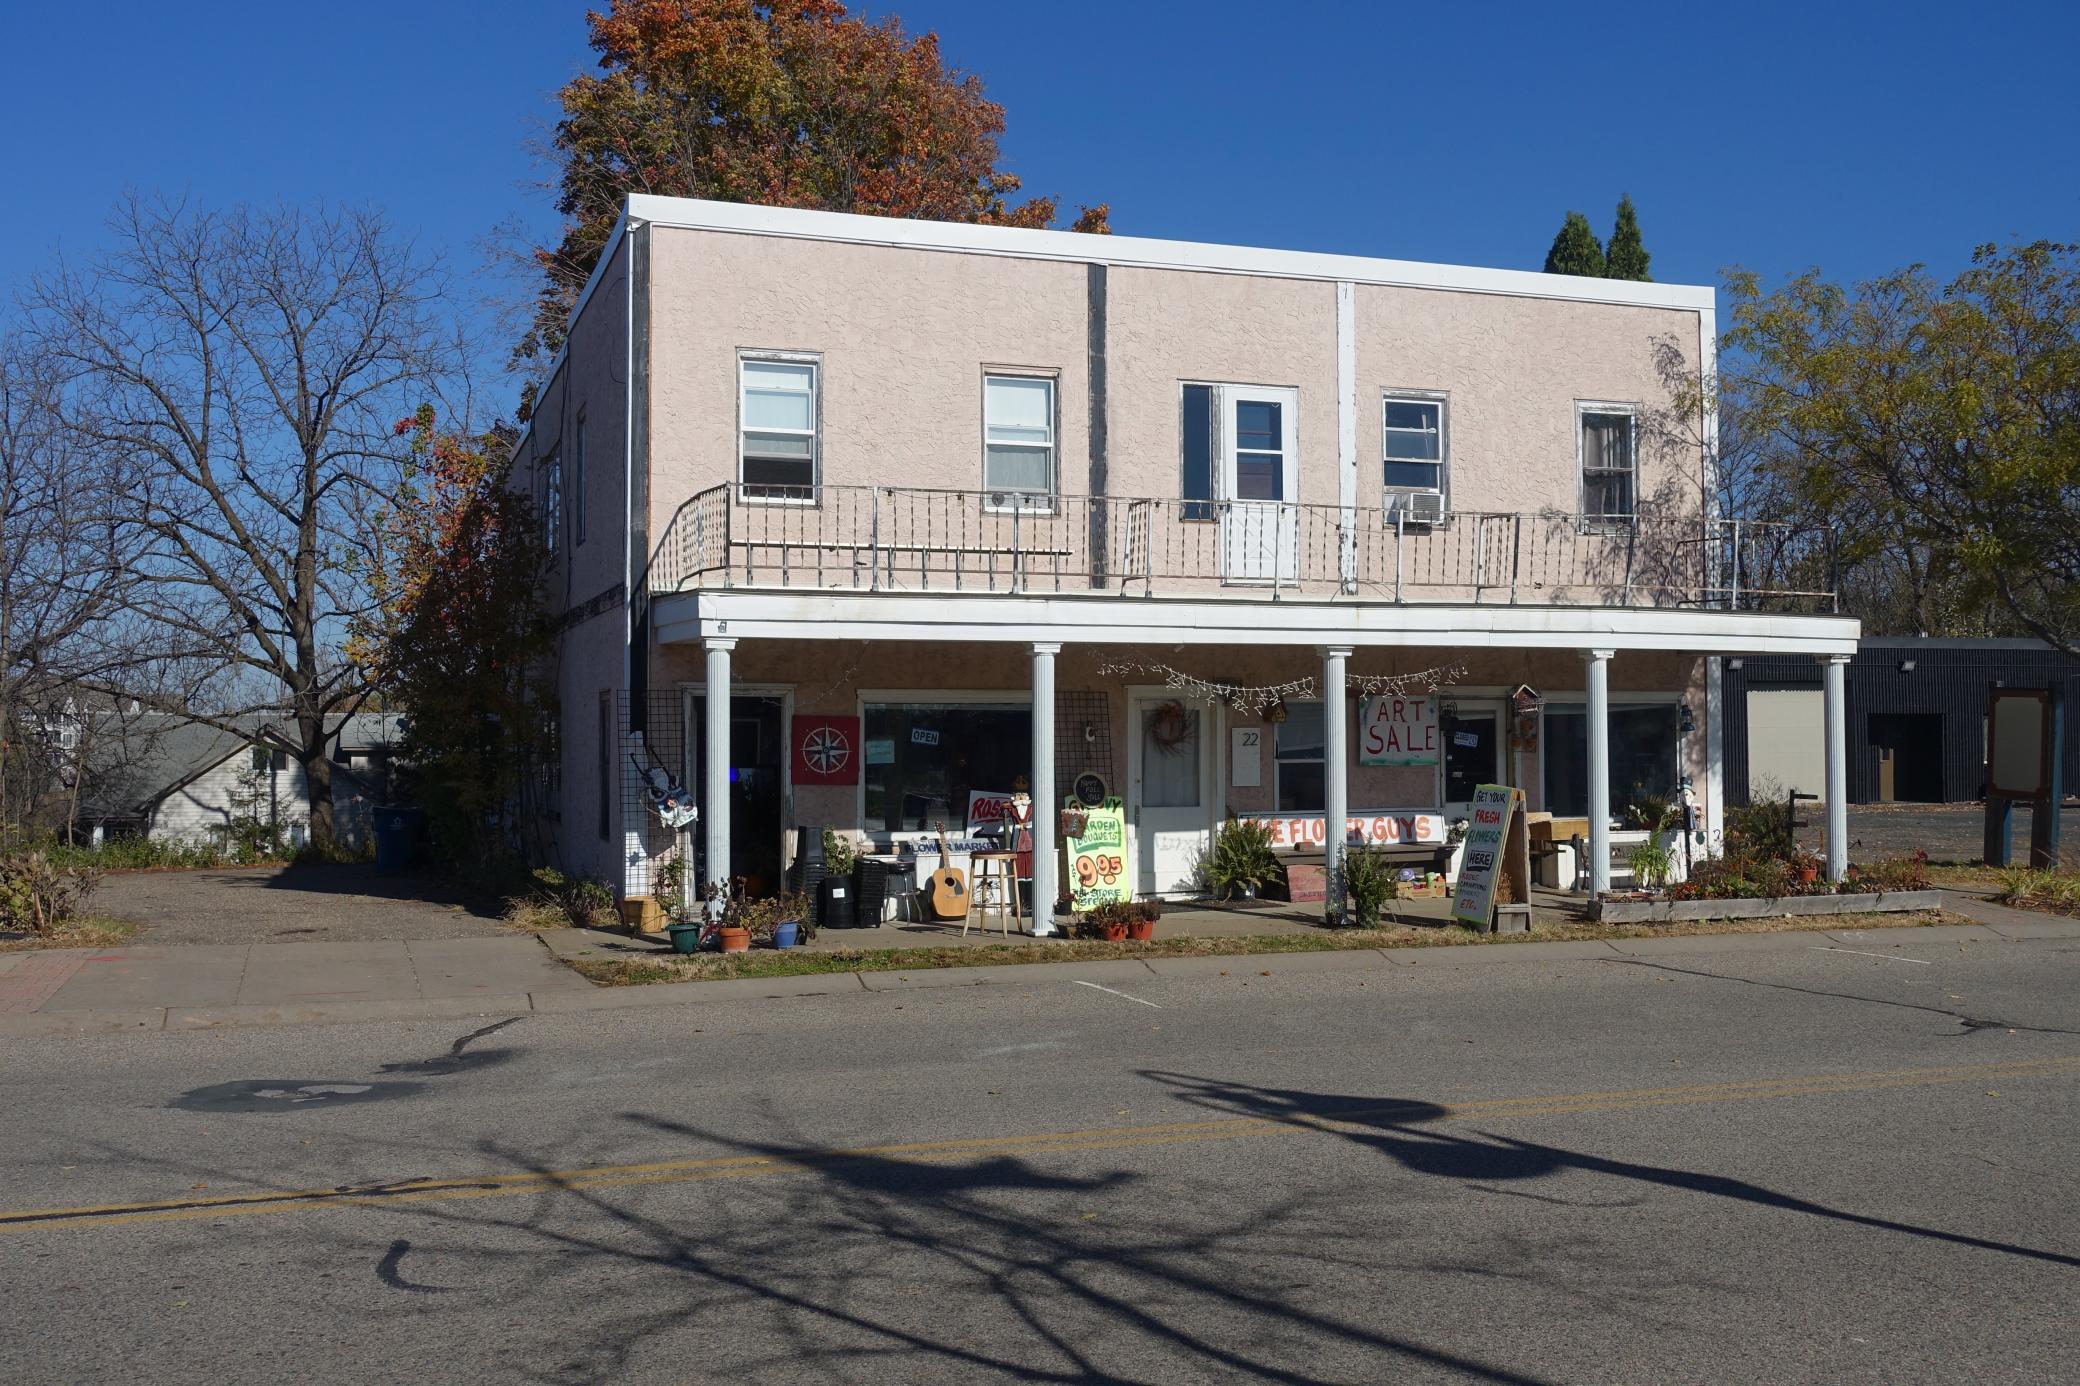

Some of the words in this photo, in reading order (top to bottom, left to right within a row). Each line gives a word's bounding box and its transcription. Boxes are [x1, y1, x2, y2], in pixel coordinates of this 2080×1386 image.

[1376, 700, 1425, 723] ART
[913, 731, 938, 744] OPEN
[1242, 732, 1259, 747] 22
[1366, 724, 1436, 755] SALE
[1476, 790, 1488, 803] GET
[1490, 791, 1506, 804] YOUR
[1475, 809, 1501, 824] FRESH
[1086, 820, 1116, 832] ARDEN
[1289, 817, 1365, 844] FLOER
[1372, 815, 1432, 841] GUYS
[1469, 852, 1491, 866] HERE
